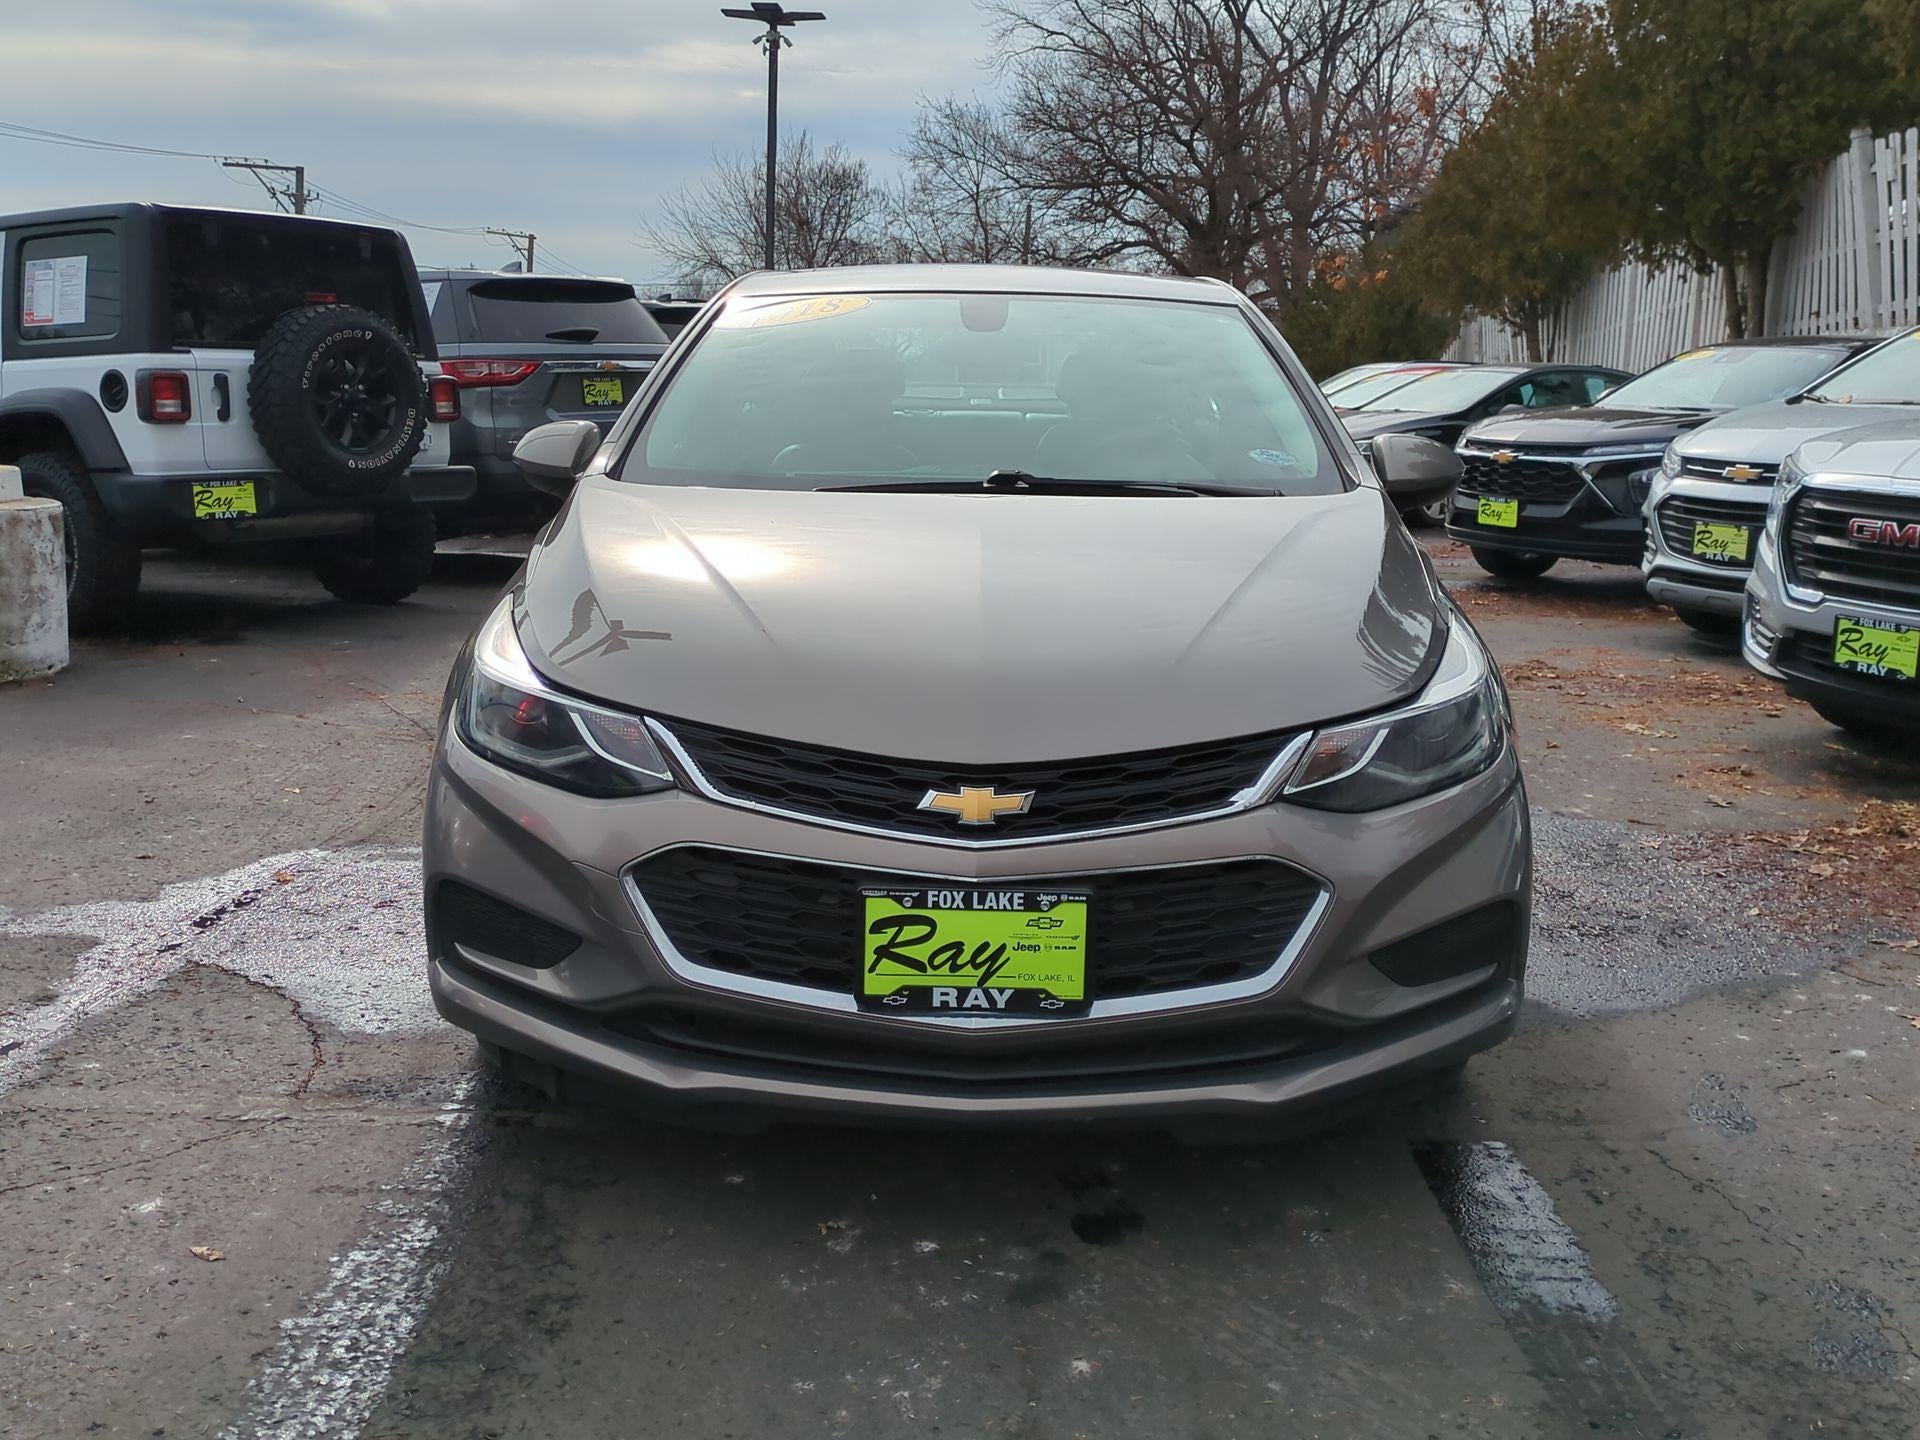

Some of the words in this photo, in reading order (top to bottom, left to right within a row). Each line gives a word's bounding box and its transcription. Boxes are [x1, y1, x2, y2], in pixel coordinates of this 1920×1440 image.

[584, 383, 609, 400] Ray
[194, 489, 235, 511] Ray
[215, 510, 238, 519] RAY
[1480, 503, 1503, 522] Ray
[1696, 530, 1729, 554] Ray
[1705, 552, 1730, 562] RAY
[1859, 617, 1874, 629] FOX
[1875, 619, 1896, 632] LAKE
[1837, 628, 1889, 664] Ray
[1857, 662, 1888, 677] RAY
[927, 890, 965, 909] FOX
[972, 890, 1025, 911] LAKE
[1036, 893, 1058, 902] Jeep
[867, 914, 1011, 987] Ray
[1012, 941, 1041, 954] Jeep
[1017, 973, 1036, 982] FOX
[1038, 974, 1065, 983] LAKE,
[1067, 974, 1076, 983] IL
[932, 987, 1015, 1009] RAY
